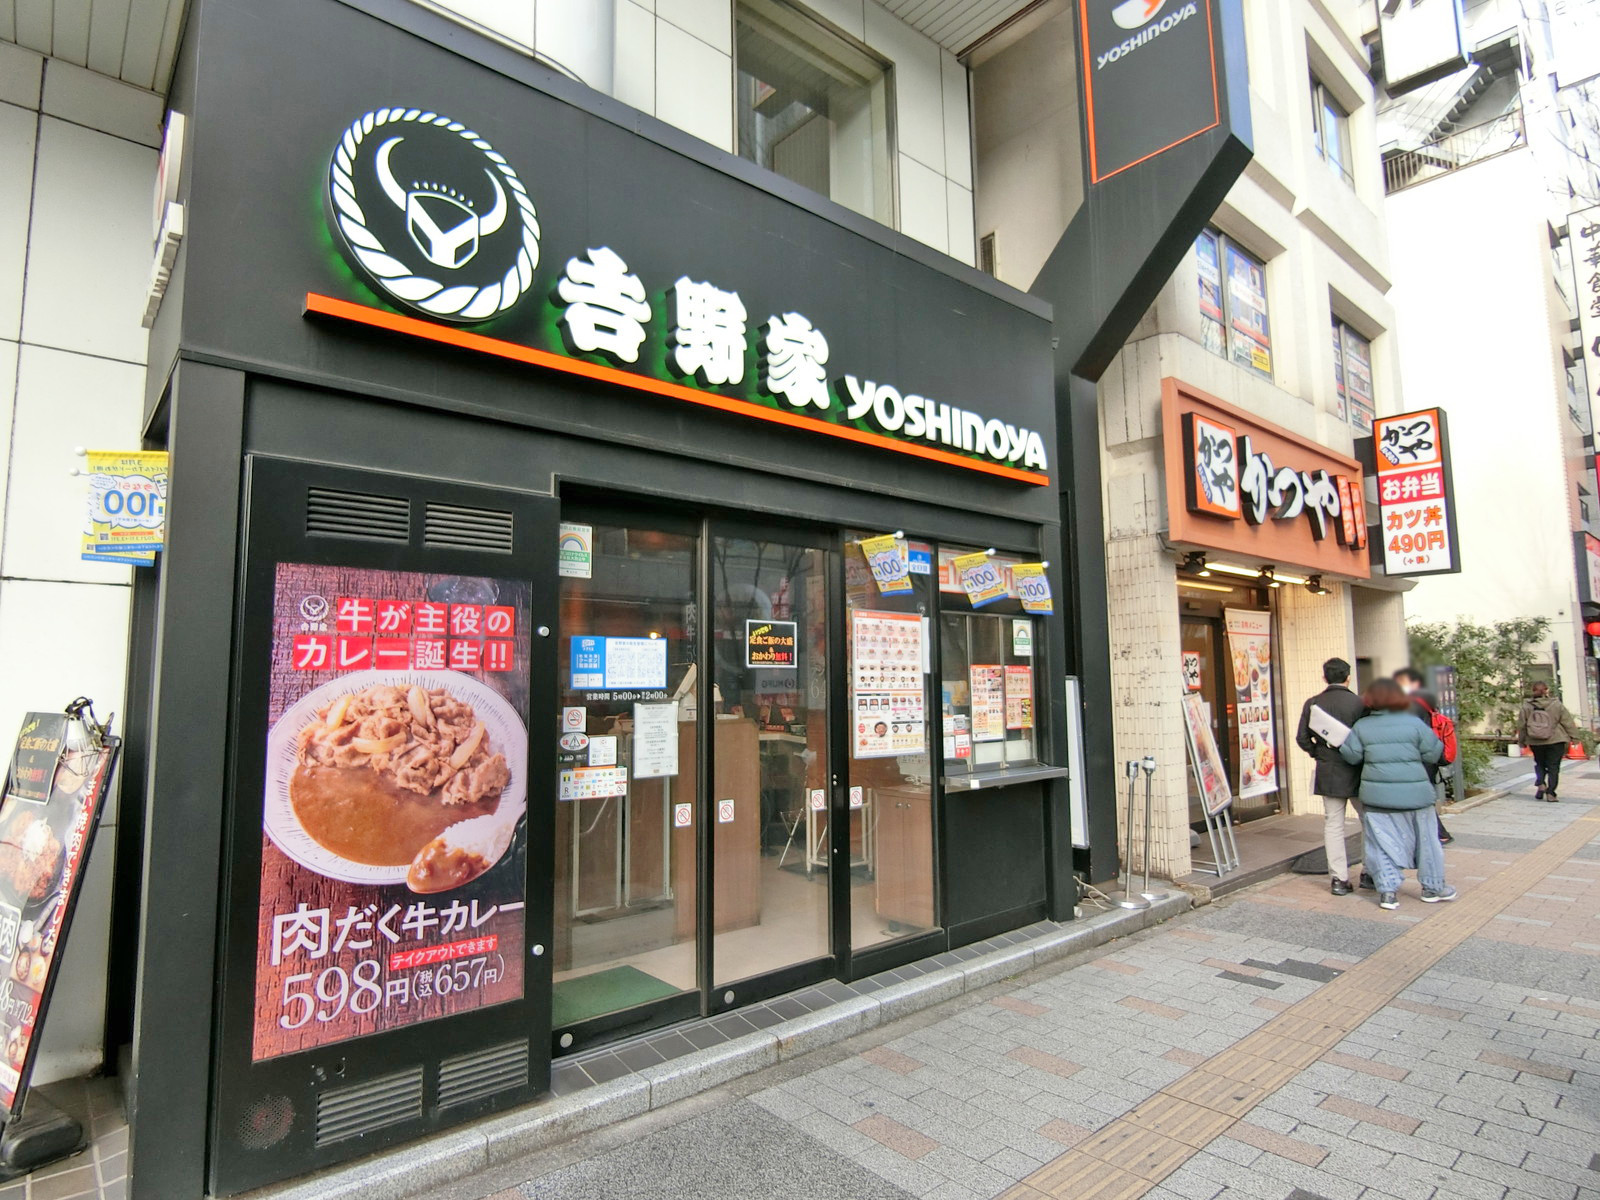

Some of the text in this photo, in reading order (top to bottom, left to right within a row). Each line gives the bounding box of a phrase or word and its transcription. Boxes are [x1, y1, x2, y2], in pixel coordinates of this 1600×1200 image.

[1097, 3, 1197, 70] YOSHINOYA
[557, 245, 831, 410] 吉野家
[844, 374, 1048, 471] YOSHINOYA
[1241, 434, 1341, 541] かつや
[1382, 472, 1441, 501] お弁当
[1387, 505, 1443, 531] カツ丼
[1388, 530, 1445, 554] 490円
[338, 600, 511, 635] 牛が主役の
[297, 637, 507, 670] カレー誕生!!
[586, 692, 611, 701] 営業時間
[270, 899, 525, 966] 肉だく牛カレー
[391, 937, 497, 968] テイクアウトできます
[279, 959, 410, 1030] 598円
